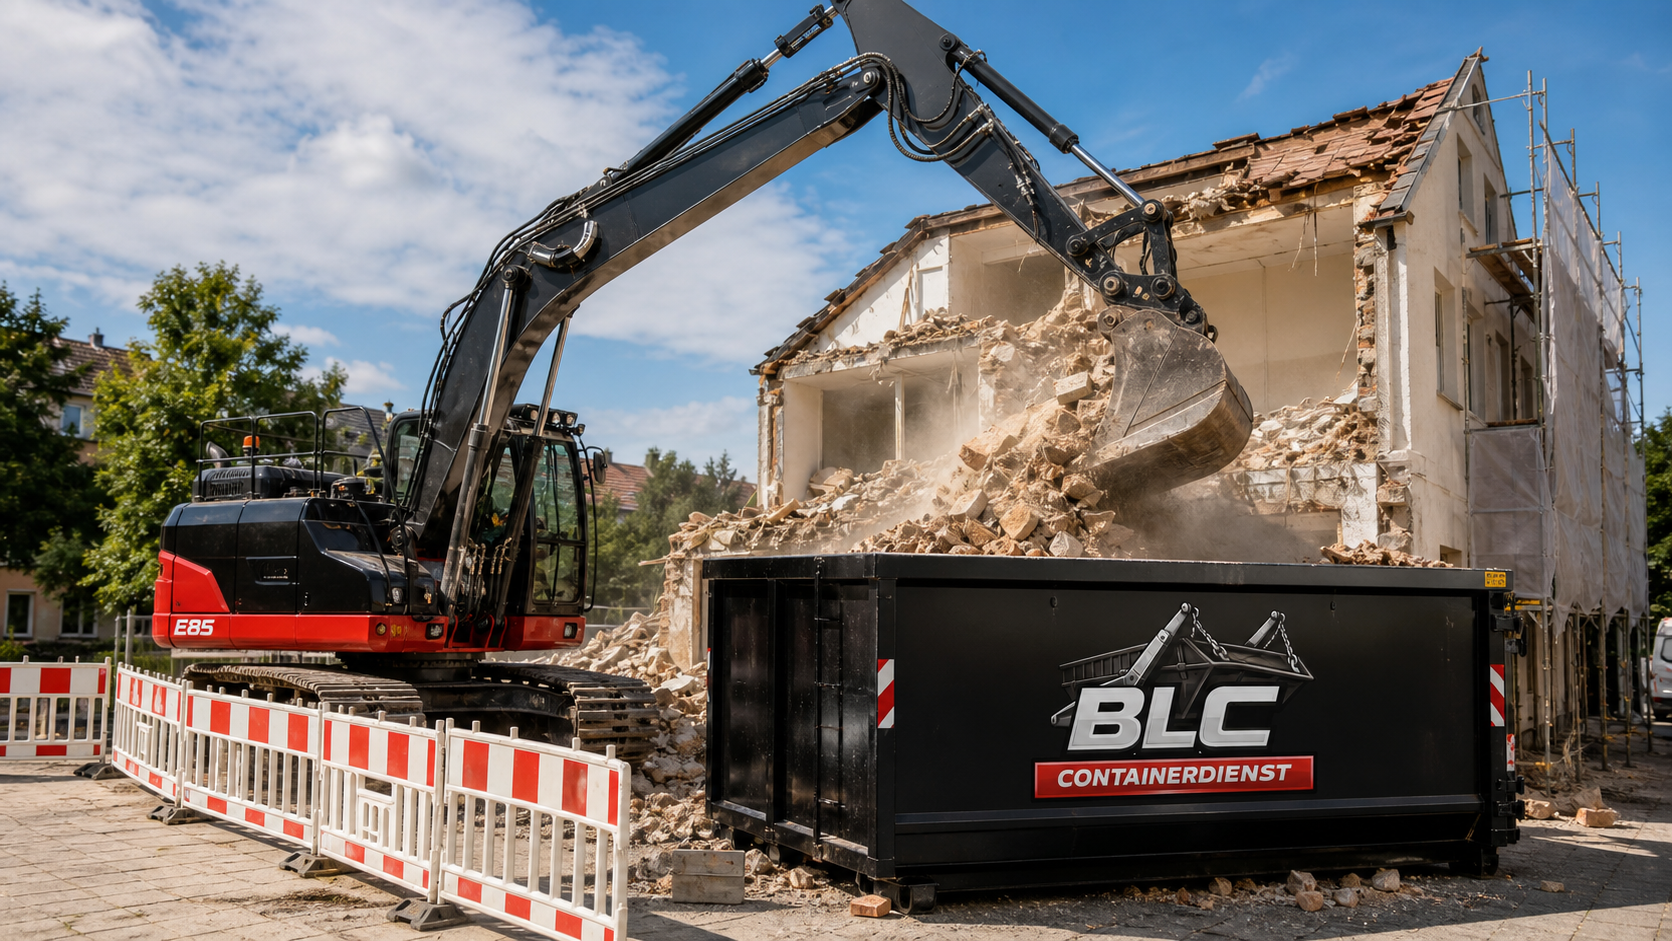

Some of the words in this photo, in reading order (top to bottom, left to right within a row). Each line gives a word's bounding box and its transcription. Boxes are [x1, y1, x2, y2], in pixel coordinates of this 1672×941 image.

[173, 618, 215, 636] E85
[1067, 686, 1280, 751] BLC
[1057, 764, 1292, 788] CONTAINERDIENST
